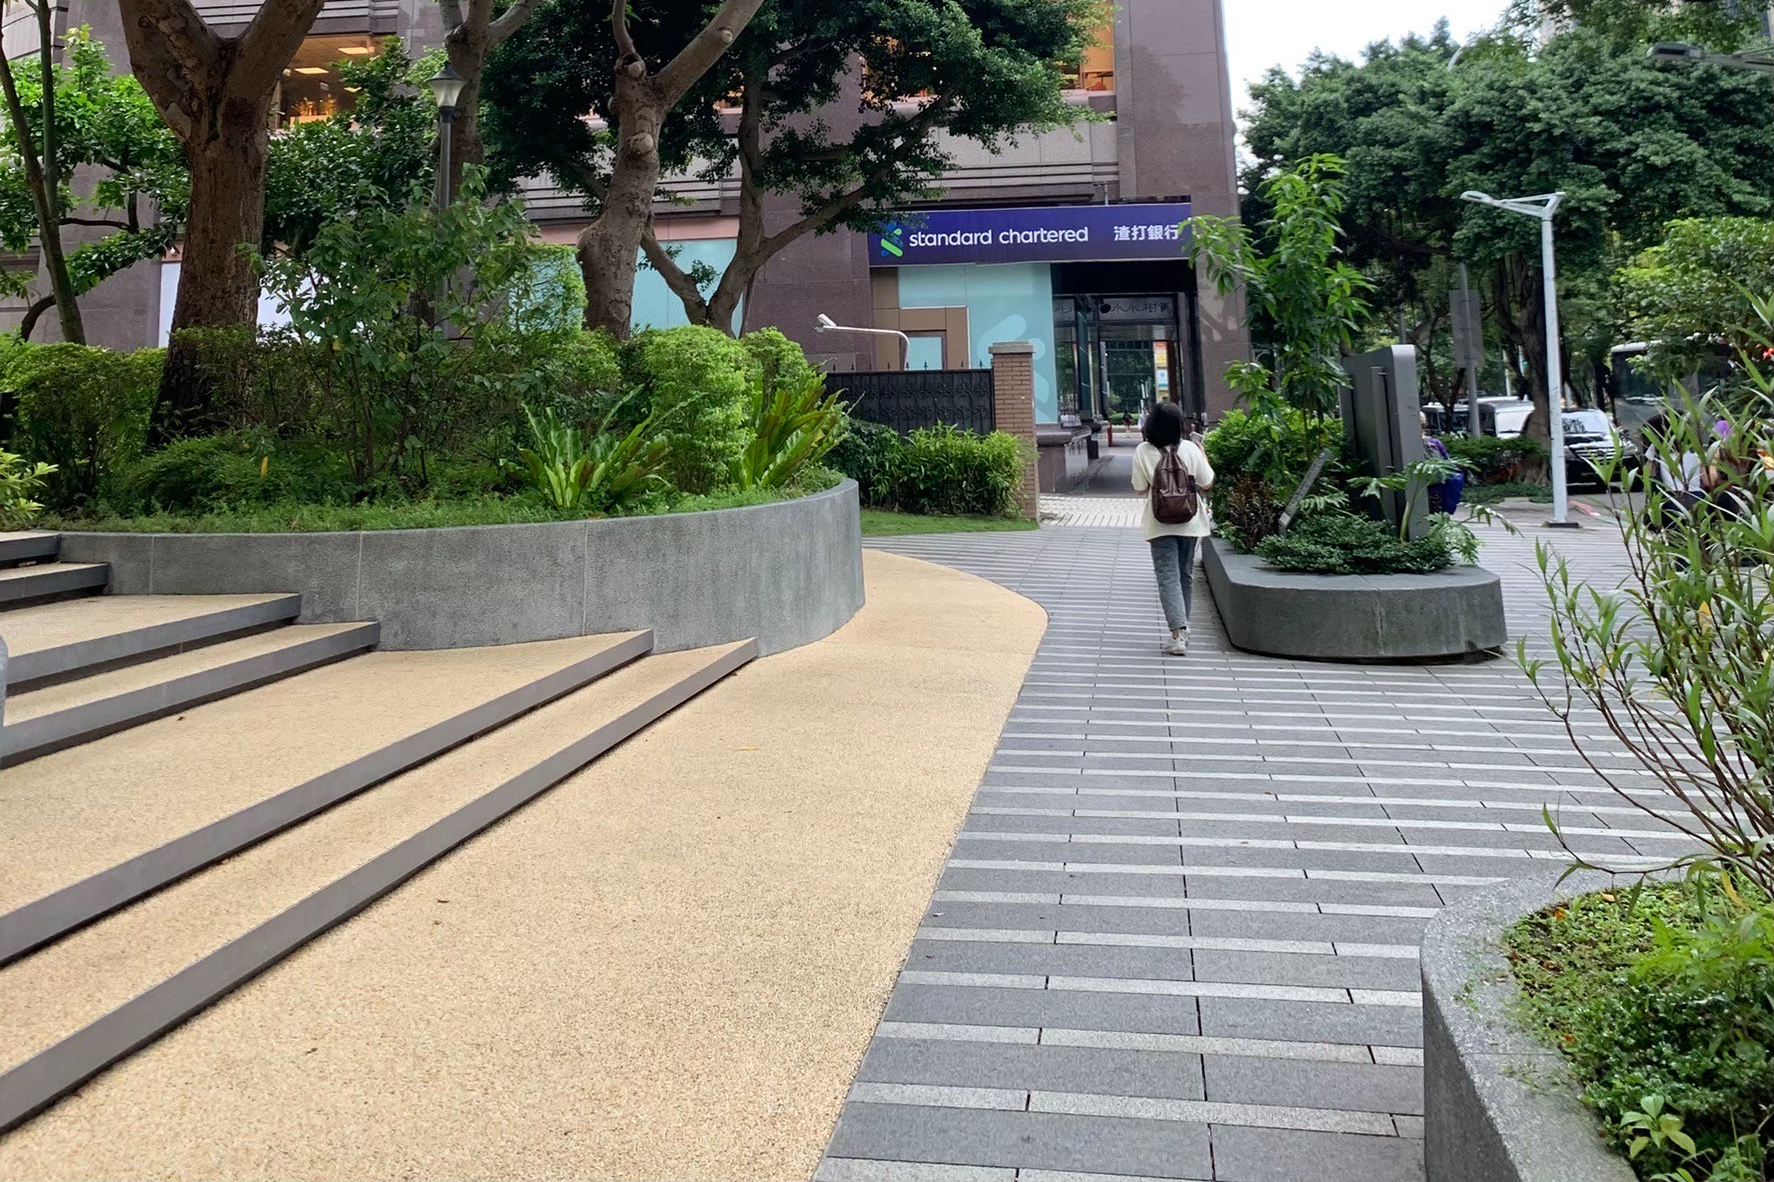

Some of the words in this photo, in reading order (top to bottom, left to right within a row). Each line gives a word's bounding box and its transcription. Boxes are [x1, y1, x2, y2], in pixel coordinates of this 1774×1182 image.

[909, 229, 992, 247] standard
[999, 226, 1089, 244] chartered
[1113, 224, 1179, 241] 渣打銀行
